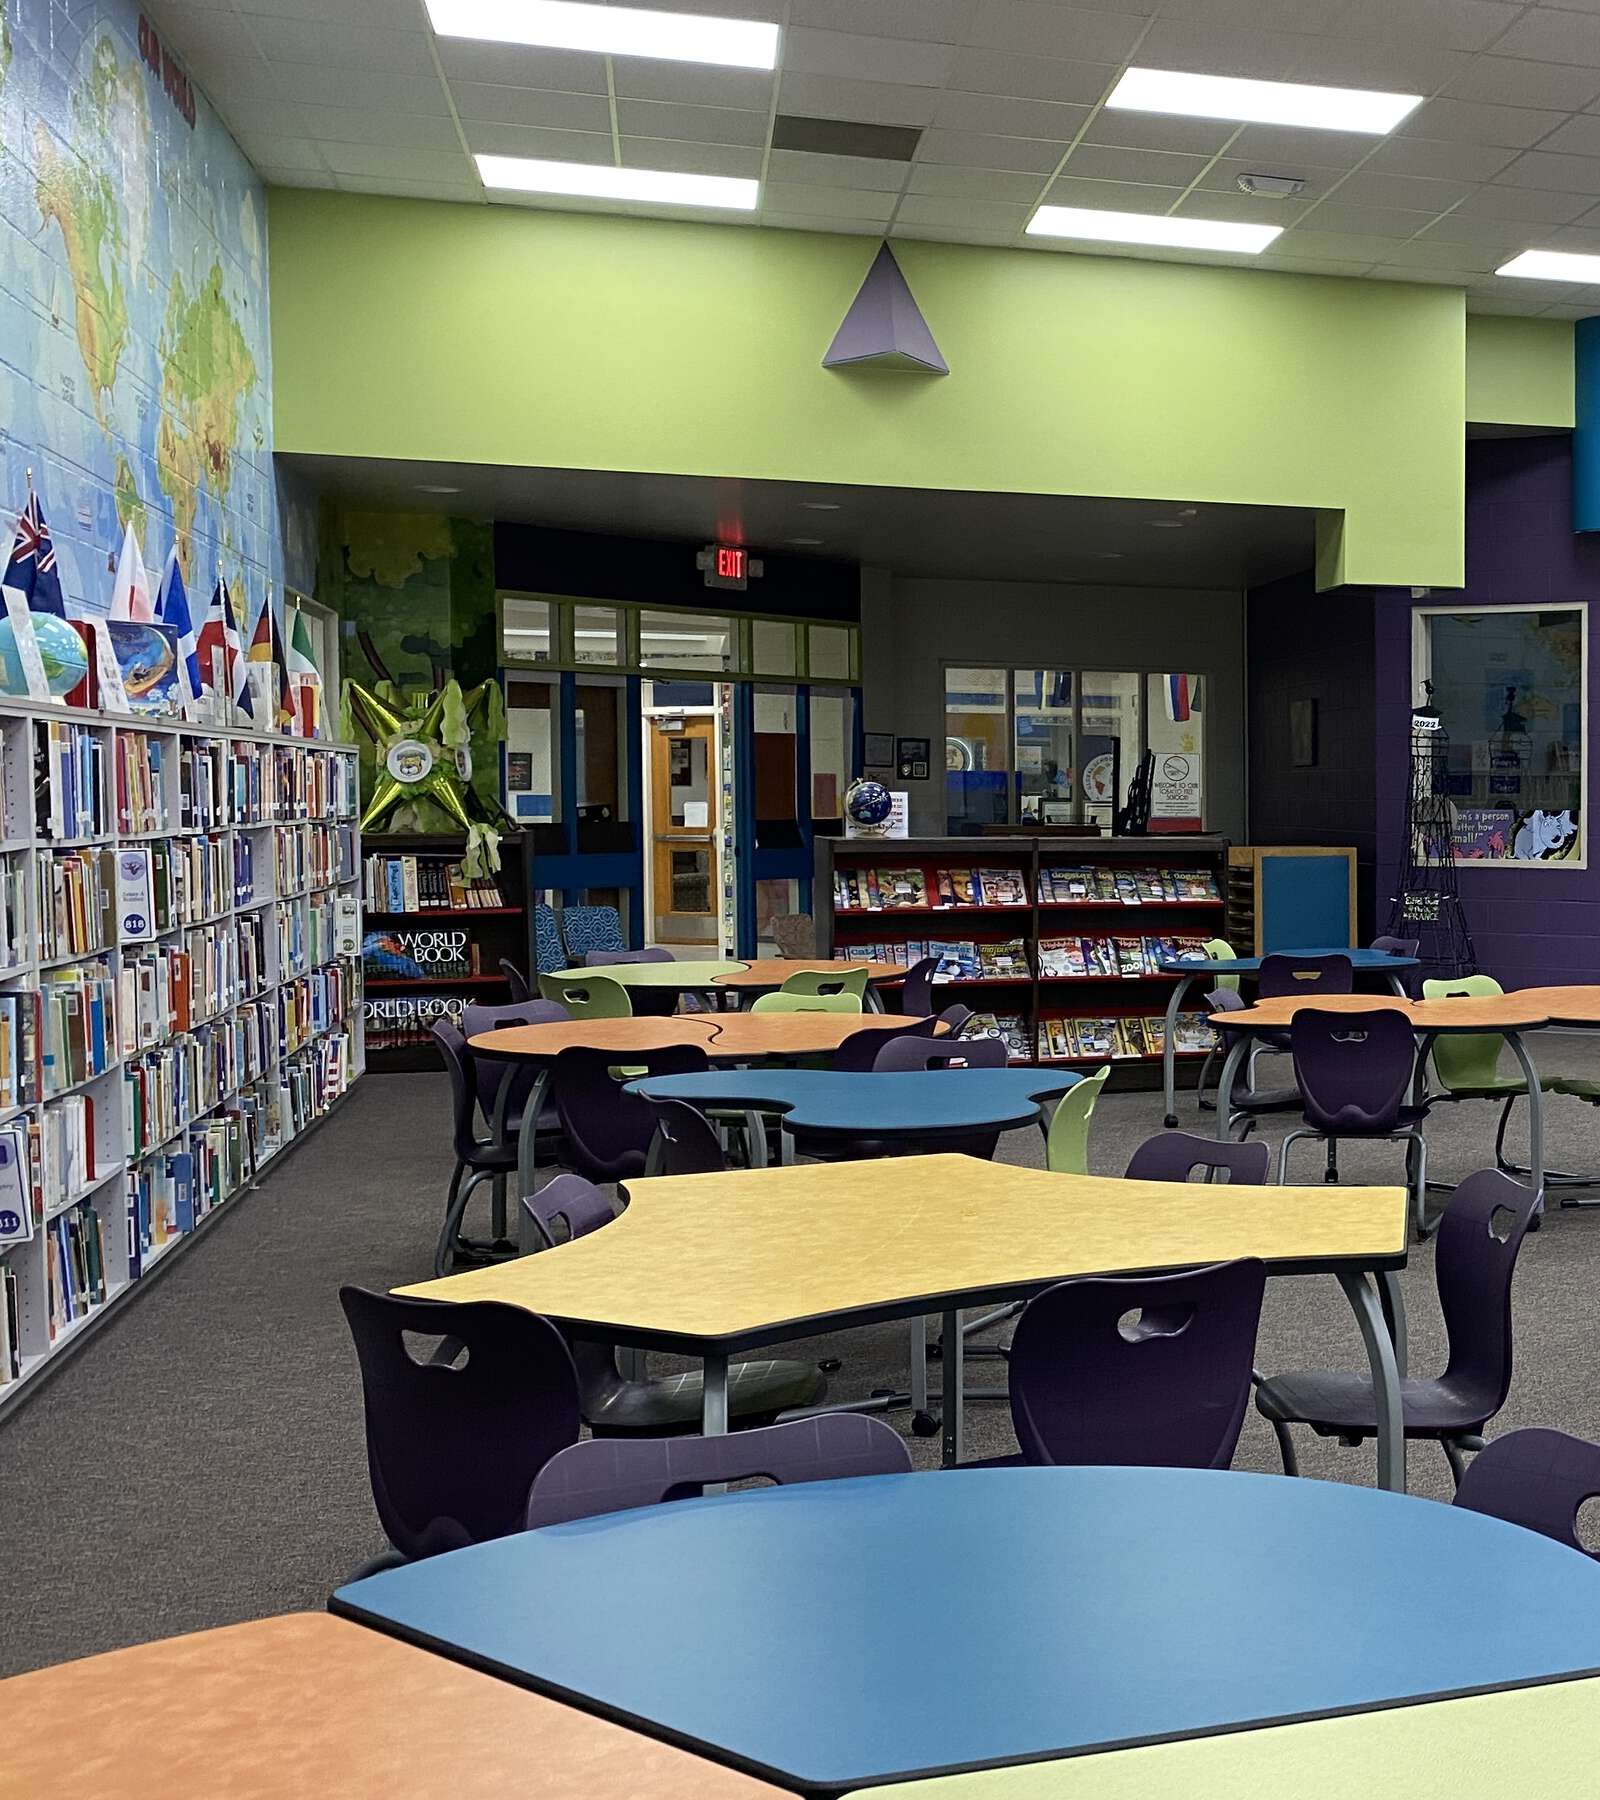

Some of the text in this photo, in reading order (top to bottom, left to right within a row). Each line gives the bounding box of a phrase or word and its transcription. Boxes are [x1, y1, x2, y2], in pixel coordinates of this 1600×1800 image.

[719, 549, 742, 578] EXIT
[1414, 719, 1436, 728] 2022
[1458, 811, 1473, 821] on's
[1482, 813, 1510, 823] person
[1456, 822, 1494, 831] atter how
[1408, 912, 1440, 921] FRANCE
[125, 919, 145, 929] 818
[397, 932, 467, 948] WORLD
[414, 947, 465, 963] BOOK
[363, 998, 476, 1019] ORLD BOOK
